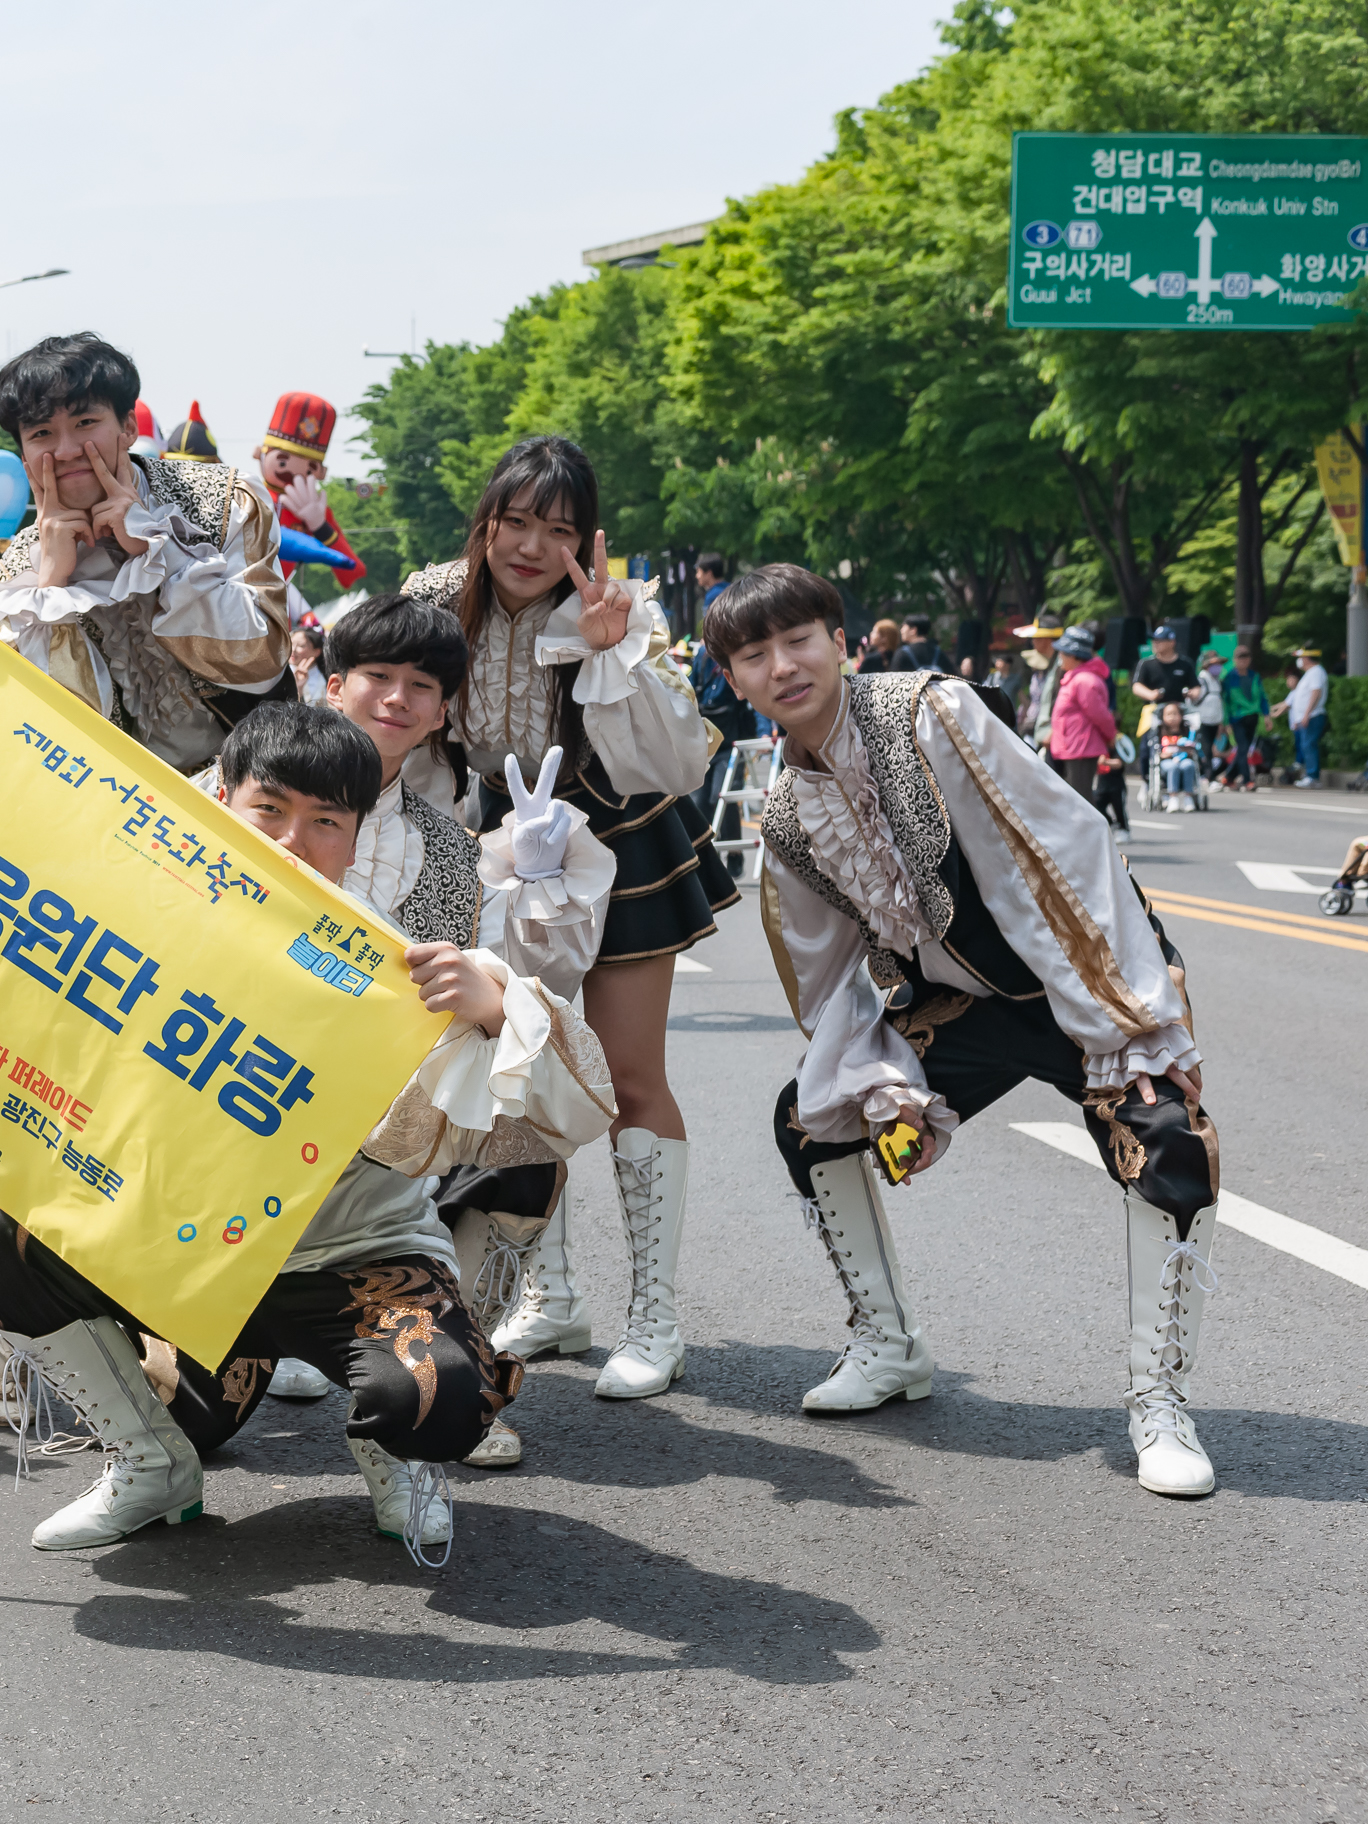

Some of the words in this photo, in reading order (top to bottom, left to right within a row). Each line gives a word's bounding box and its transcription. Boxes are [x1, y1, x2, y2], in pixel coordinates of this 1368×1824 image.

[1091, 148, 1205, 179] 청담대교
[1072, 184, 1205, 215] 건대입구역
[1211, 195, 1269, 216] Konkuk
[1273, 195, 1309, 216] Univ
[1311, 195, 1340, 216] Stn
[1036, 225, 1050, 244] 3
[1070, 226, 1096, 246] 71
[1021, 251, 1132, 281] 구의사거리
[1020, 283, 1059, 304] Guui
[1065, 285, 1092, 304] Jct
[1162, 276, 1183, 295] 60
[1278, 286, 1352, 310] Hwayan
[1186, 303, 1234, 324] 250m
[13, 722, 94, 788] 제8회
[312, 914, 343, 942] 폴짝
[354, 943, 385, 971] 폴짝
[287, 932, 374, 997] 놀이터
[142, 989, 316, 1137] 화랑
[8, 1056, 94, 1133] 퍼레이드
[0, 1092, 63, 1150] 광진구
[61, 1139, 125, 1202] 능동로
